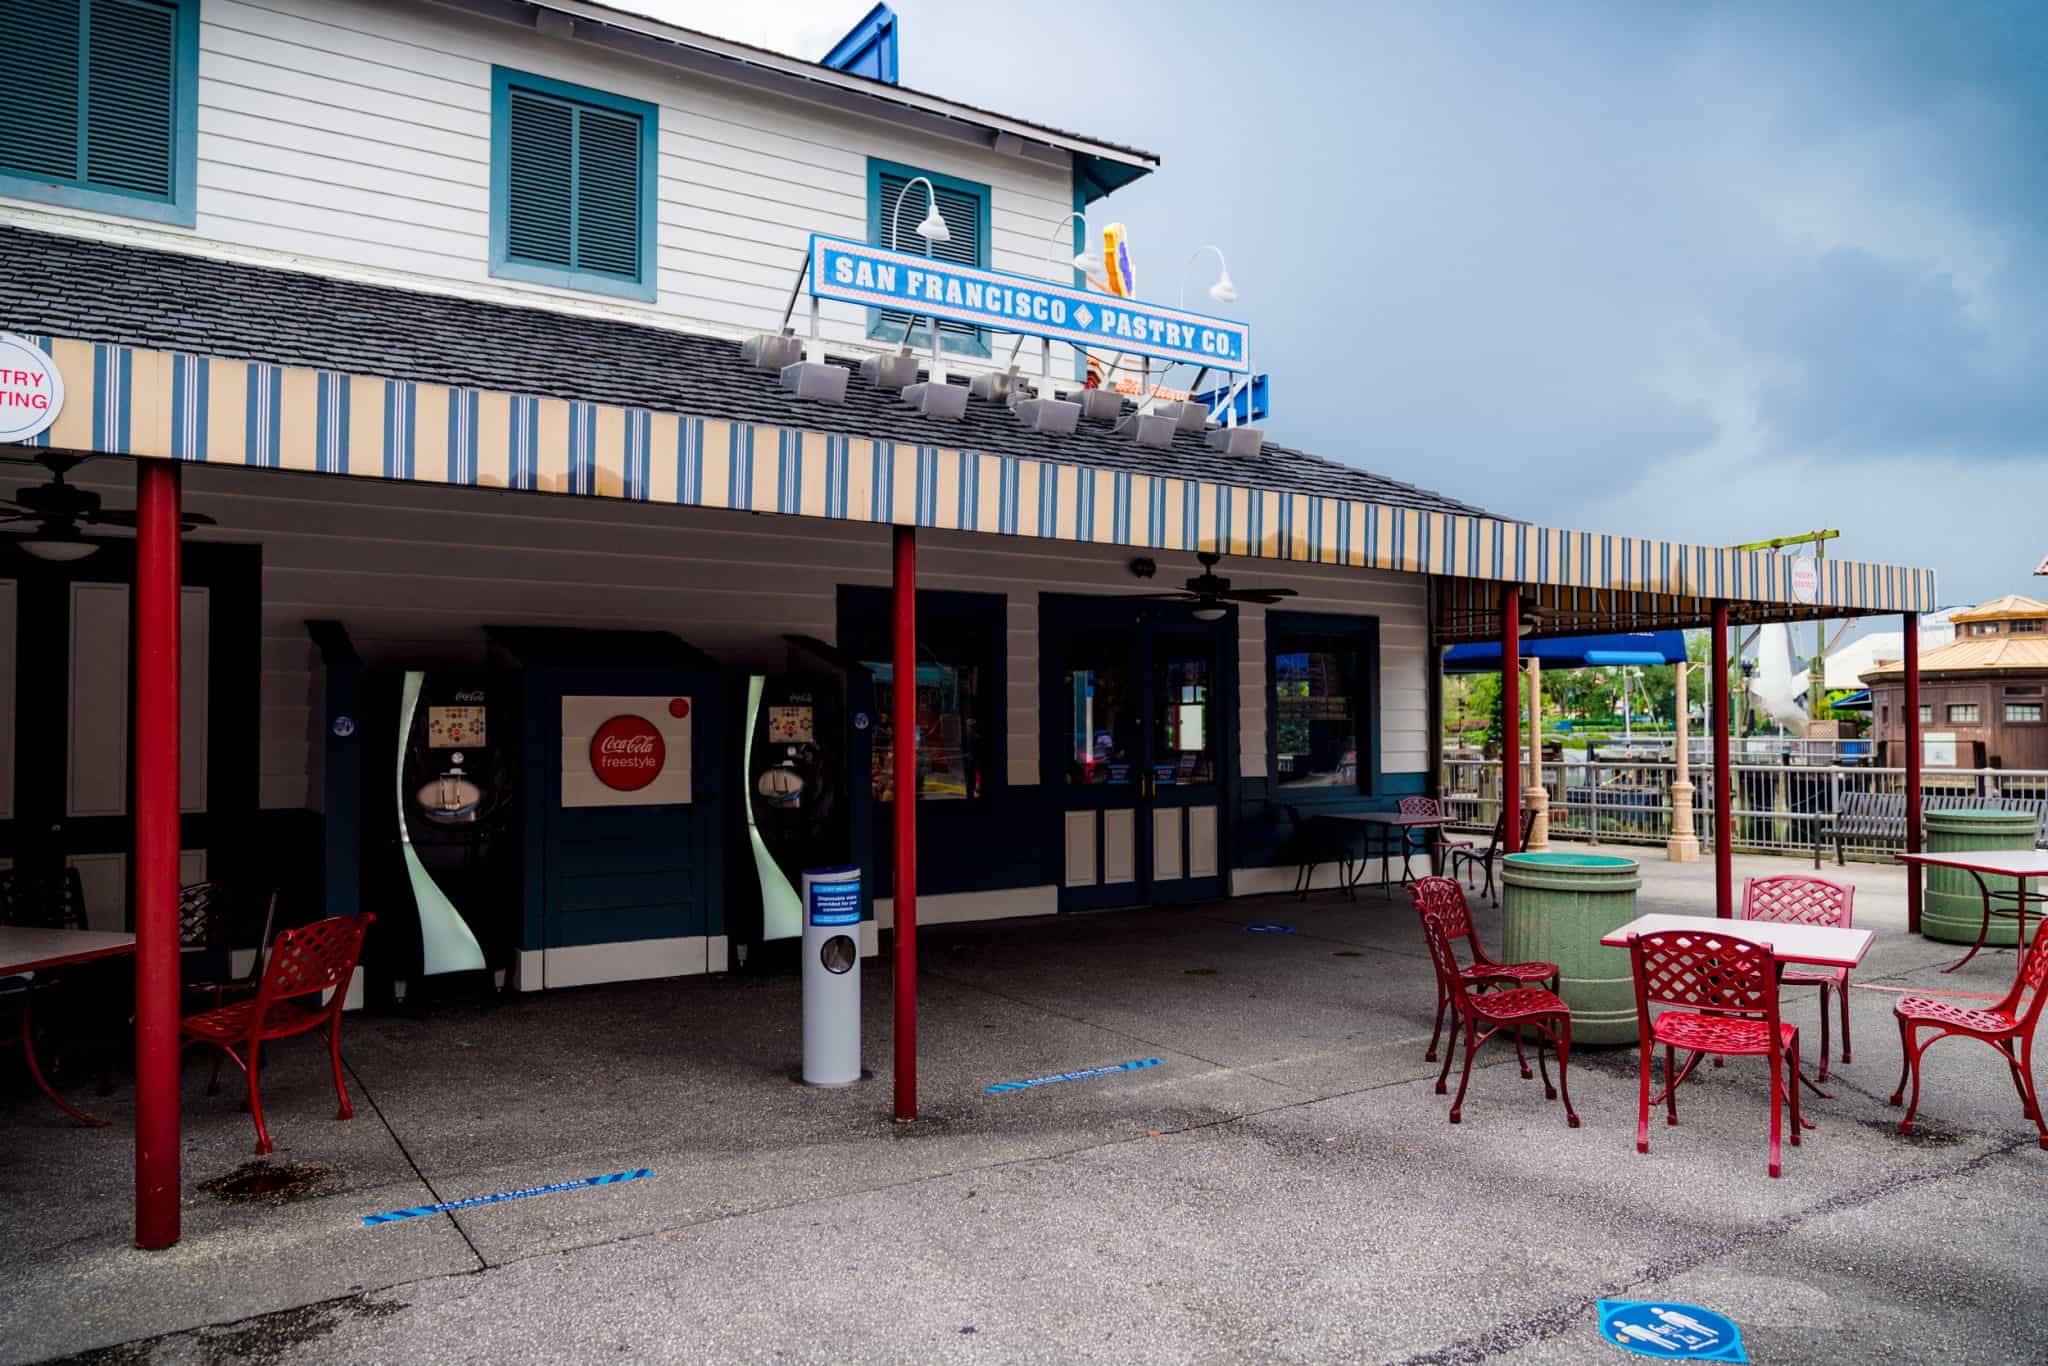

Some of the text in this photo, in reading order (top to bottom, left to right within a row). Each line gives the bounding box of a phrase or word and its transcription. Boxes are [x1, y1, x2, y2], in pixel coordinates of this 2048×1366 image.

[836, 256, 1236, 357] SAN FRANCISCO PASTRY CO.
[601, 735, 656, 754] Coca-Cola
[601, 755, 656, 769] freestyle
